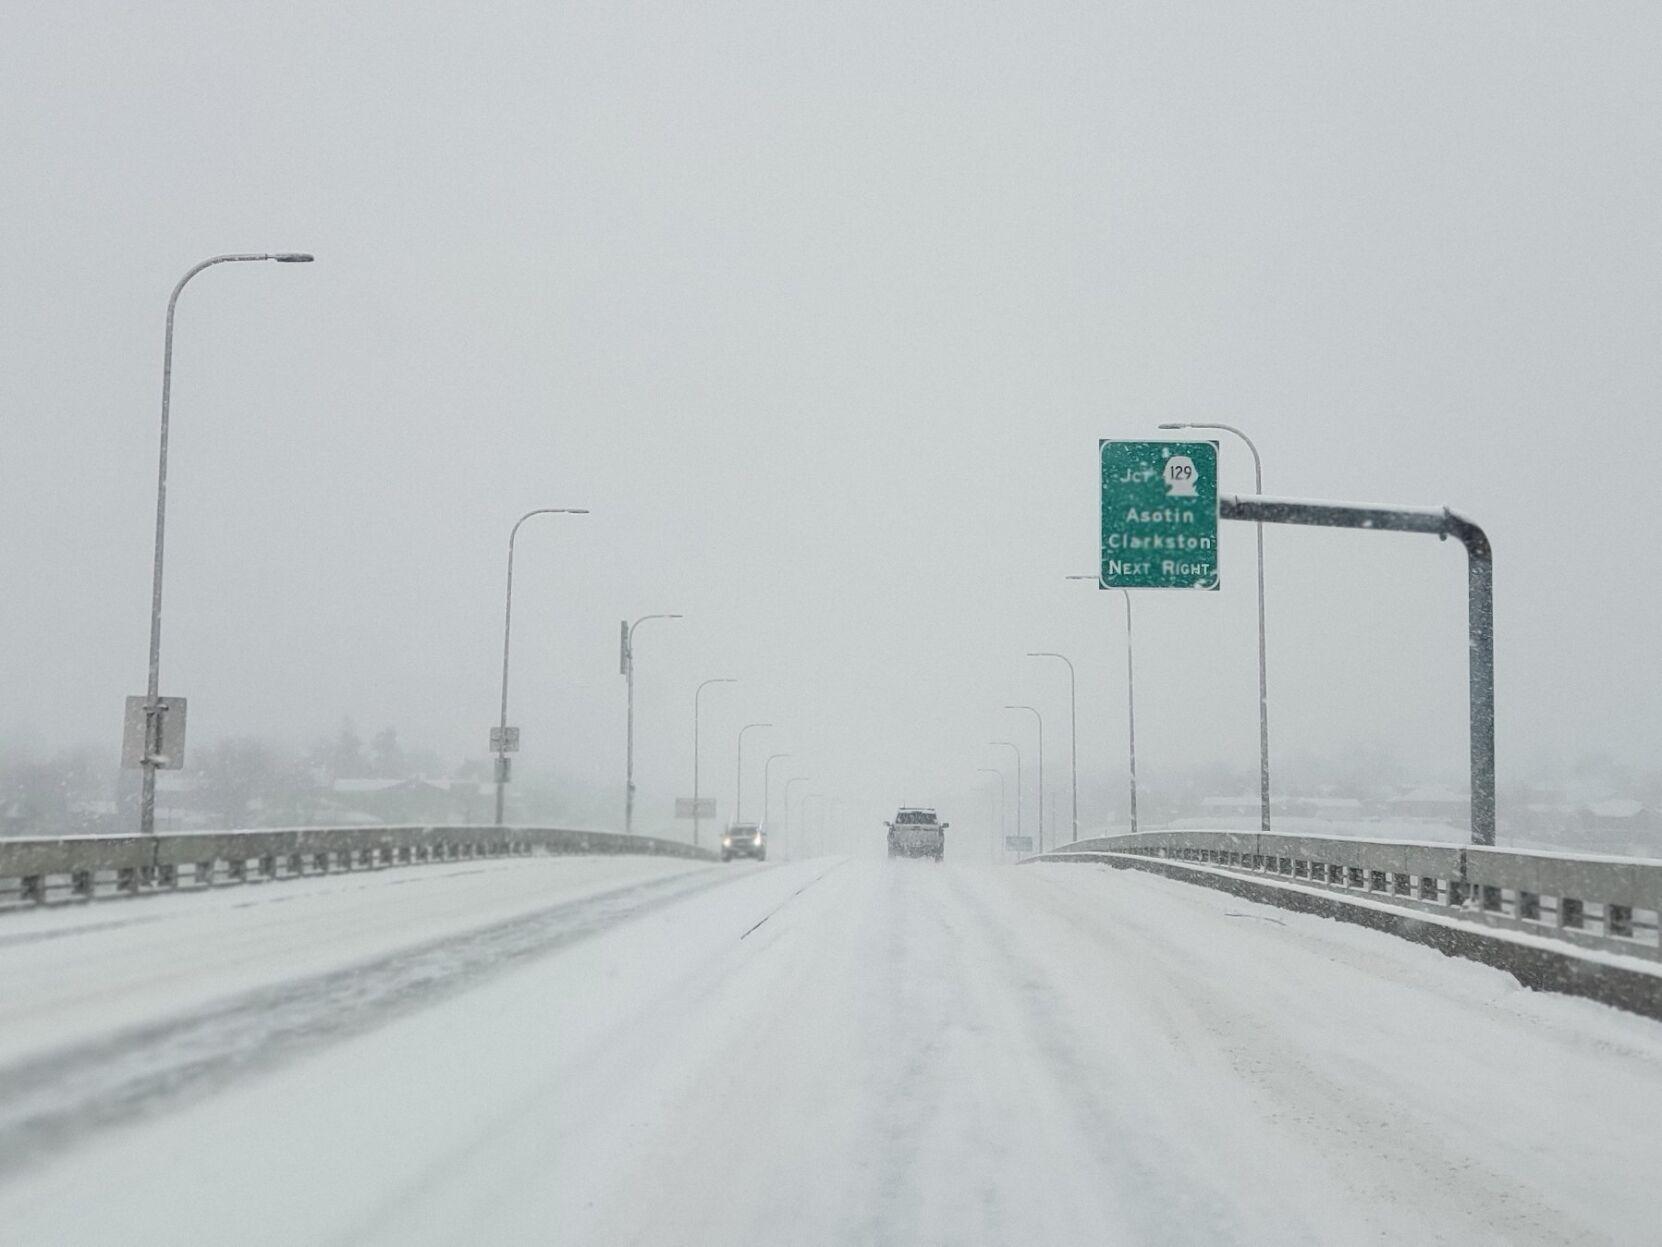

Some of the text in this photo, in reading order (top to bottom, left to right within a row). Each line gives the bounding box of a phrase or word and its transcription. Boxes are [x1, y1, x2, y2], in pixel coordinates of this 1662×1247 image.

[1170, 465, 1192, 480] 129
[1126, 507, 1194, 523] Asotin
[1108, 533, 1211, 549] Clarkston
[1108, 559, 1210, 575] NEXT RIGHT
